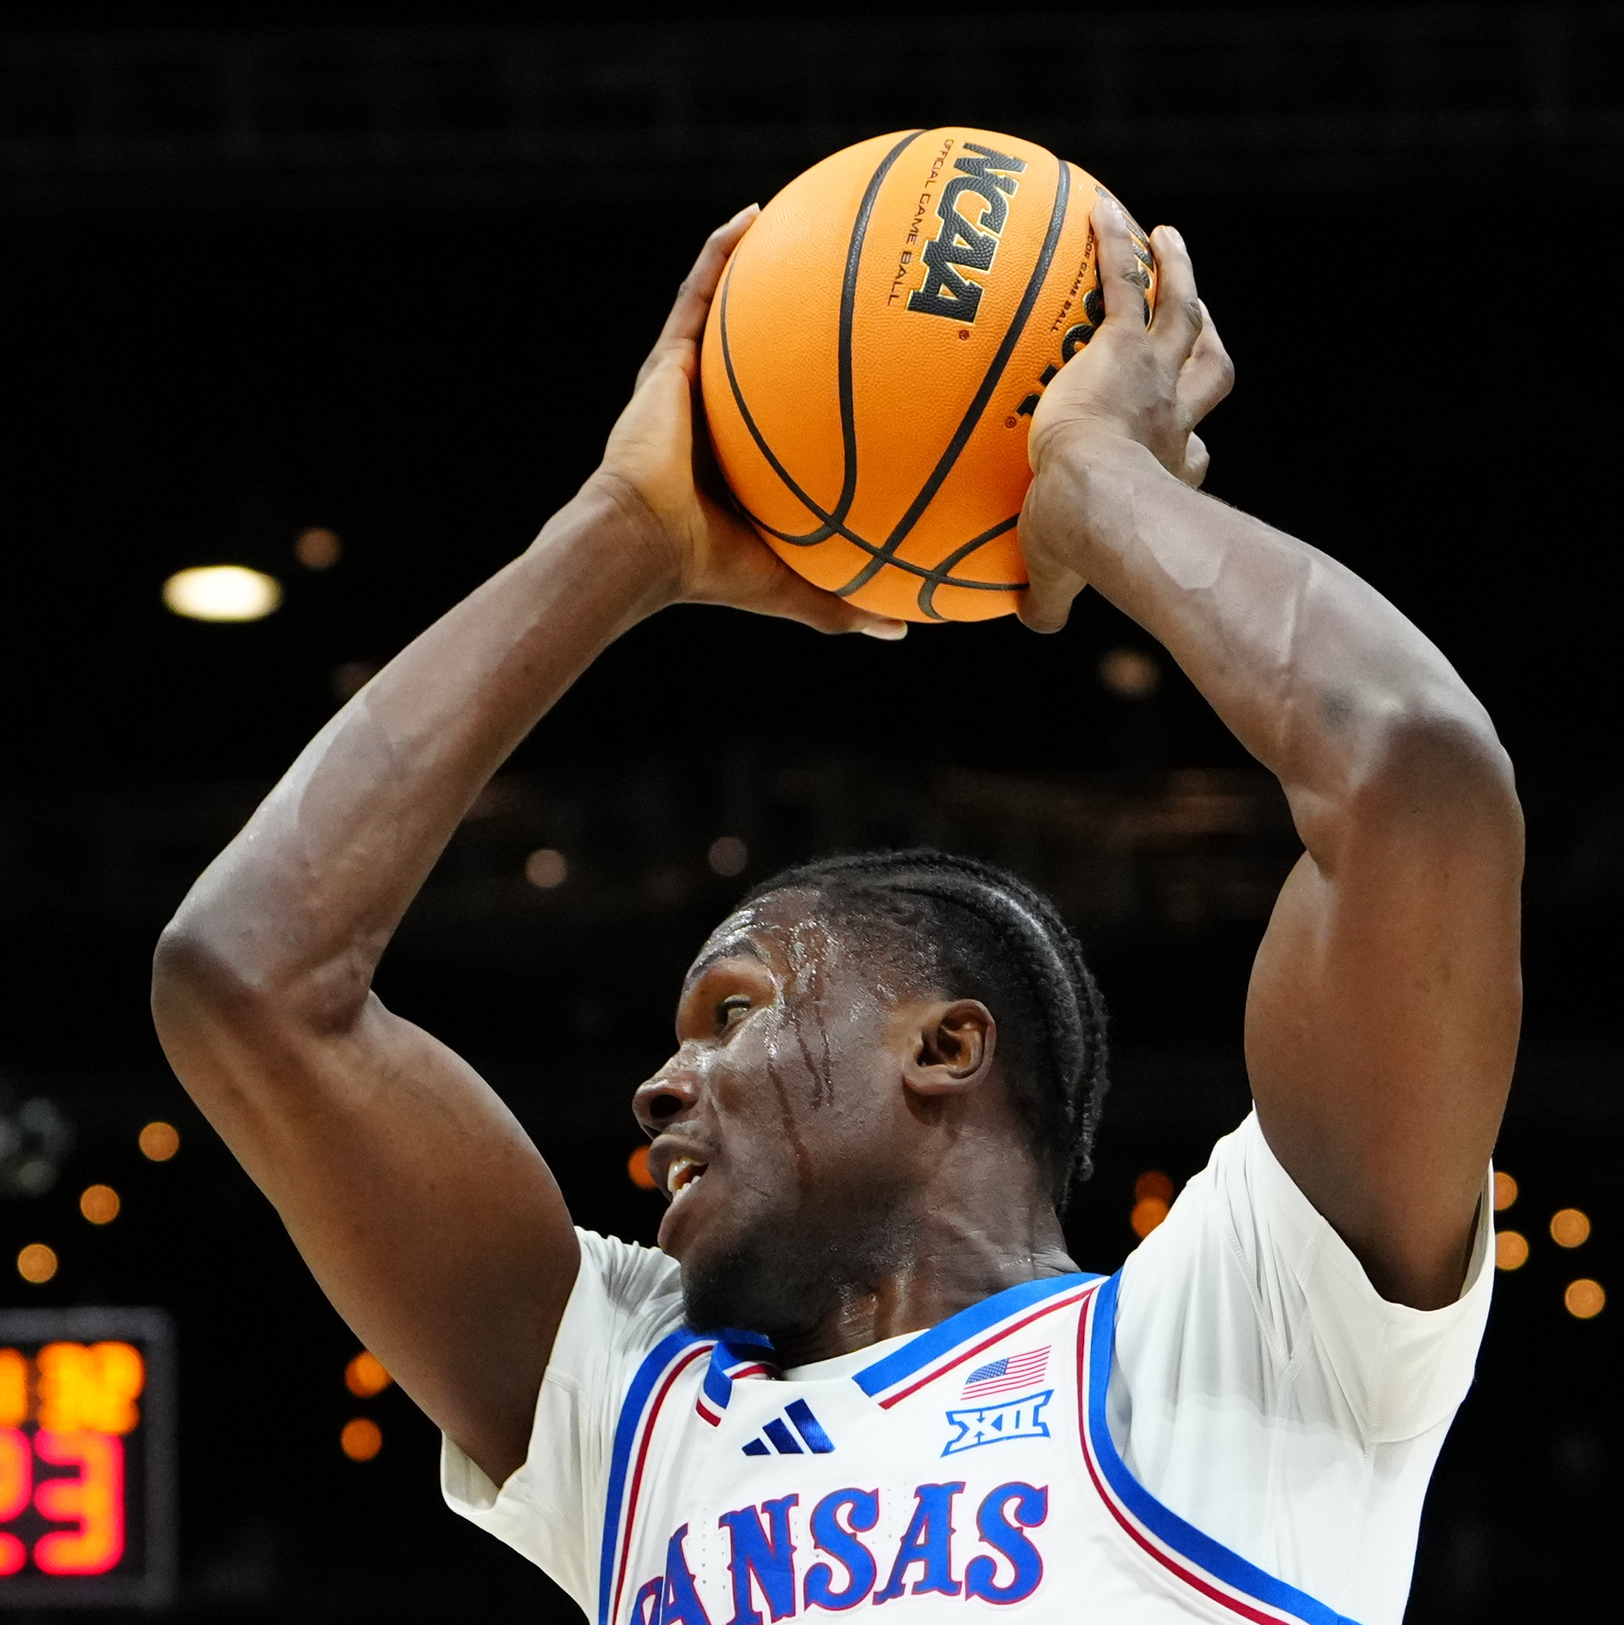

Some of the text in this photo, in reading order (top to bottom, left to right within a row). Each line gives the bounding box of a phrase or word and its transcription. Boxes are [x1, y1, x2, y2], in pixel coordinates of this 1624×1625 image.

[905, 142, 1028, 325] NCAA
[906, 193, 931, 245] GAME
[887, 250, 913, 307] BALL
[1051, 301, 1072, 333] BALL
[940, 1389, 1054, 1458] XII
